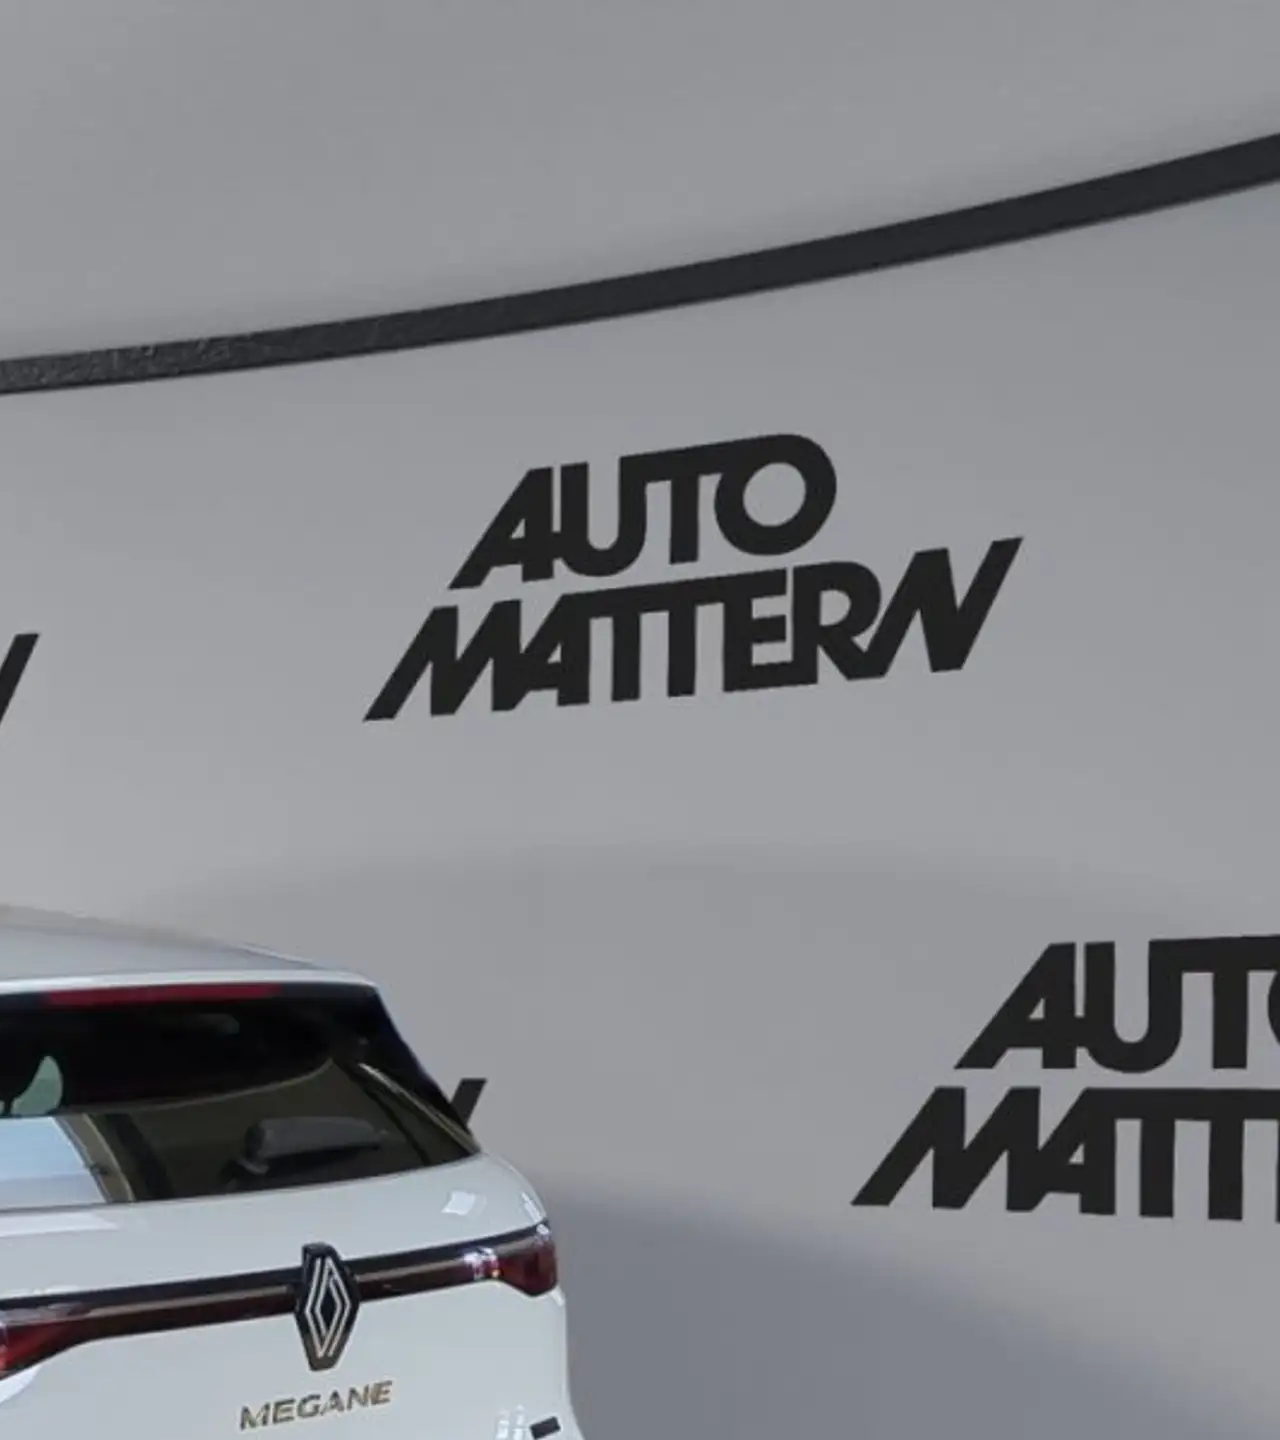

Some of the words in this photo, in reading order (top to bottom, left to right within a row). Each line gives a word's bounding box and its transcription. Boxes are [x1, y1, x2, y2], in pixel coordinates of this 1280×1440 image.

[448, 434, 837, 590] AUTO
[363, 536, 1023, 722] MATTERN
[954, 935, 1280, 1073] AUT
[851, 1087, 1280, 1223] MATT
[240, 1380, 393, 1430] MEGANE
